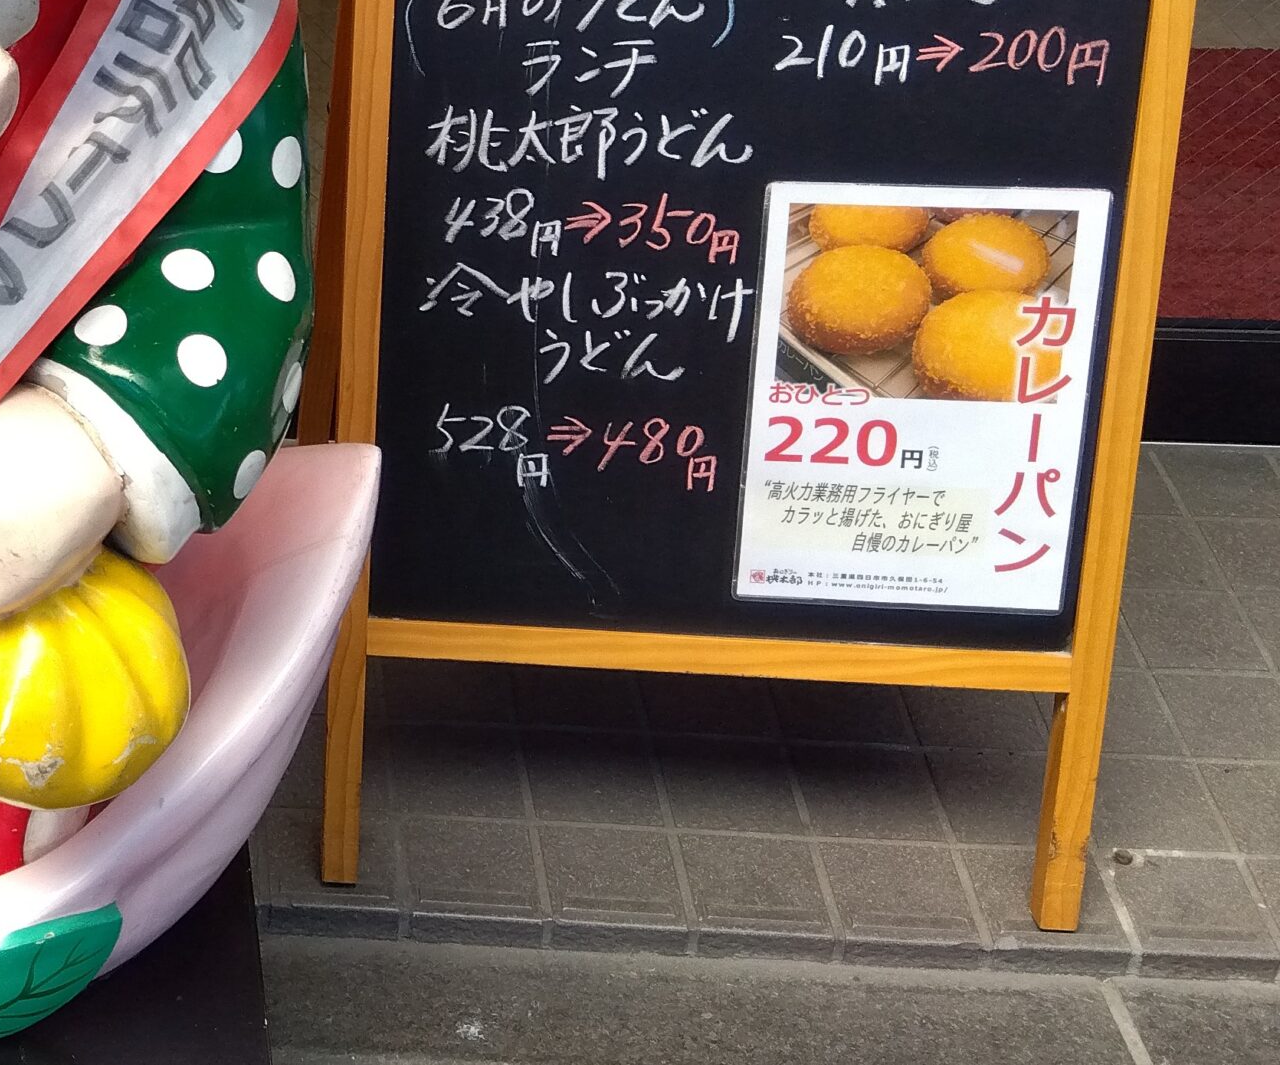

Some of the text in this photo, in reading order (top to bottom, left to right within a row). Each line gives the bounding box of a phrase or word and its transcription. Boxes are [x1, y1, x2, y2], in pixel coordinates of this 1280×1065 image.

[521, 39, 658, 98] ランチ
[774, 24, 1110, 87] 210円 200円
[426, 104, 754, 181] 桃太郎うどん
[444, 188, 740, 265] 438円 350円
[419, 262, 755, 344] 冷やしぶっかけ
[540, 328, 685, 385] うどん
[768, 382, 871, 406] おひとつ
[428, 403, 716, 492] 528円 480円
[763, 416, 924, 470] 220円
[994, 296, 1077, 573] カレーパン
[781, 505, 974, 534] カラッと揚げた、おにぎり屋
